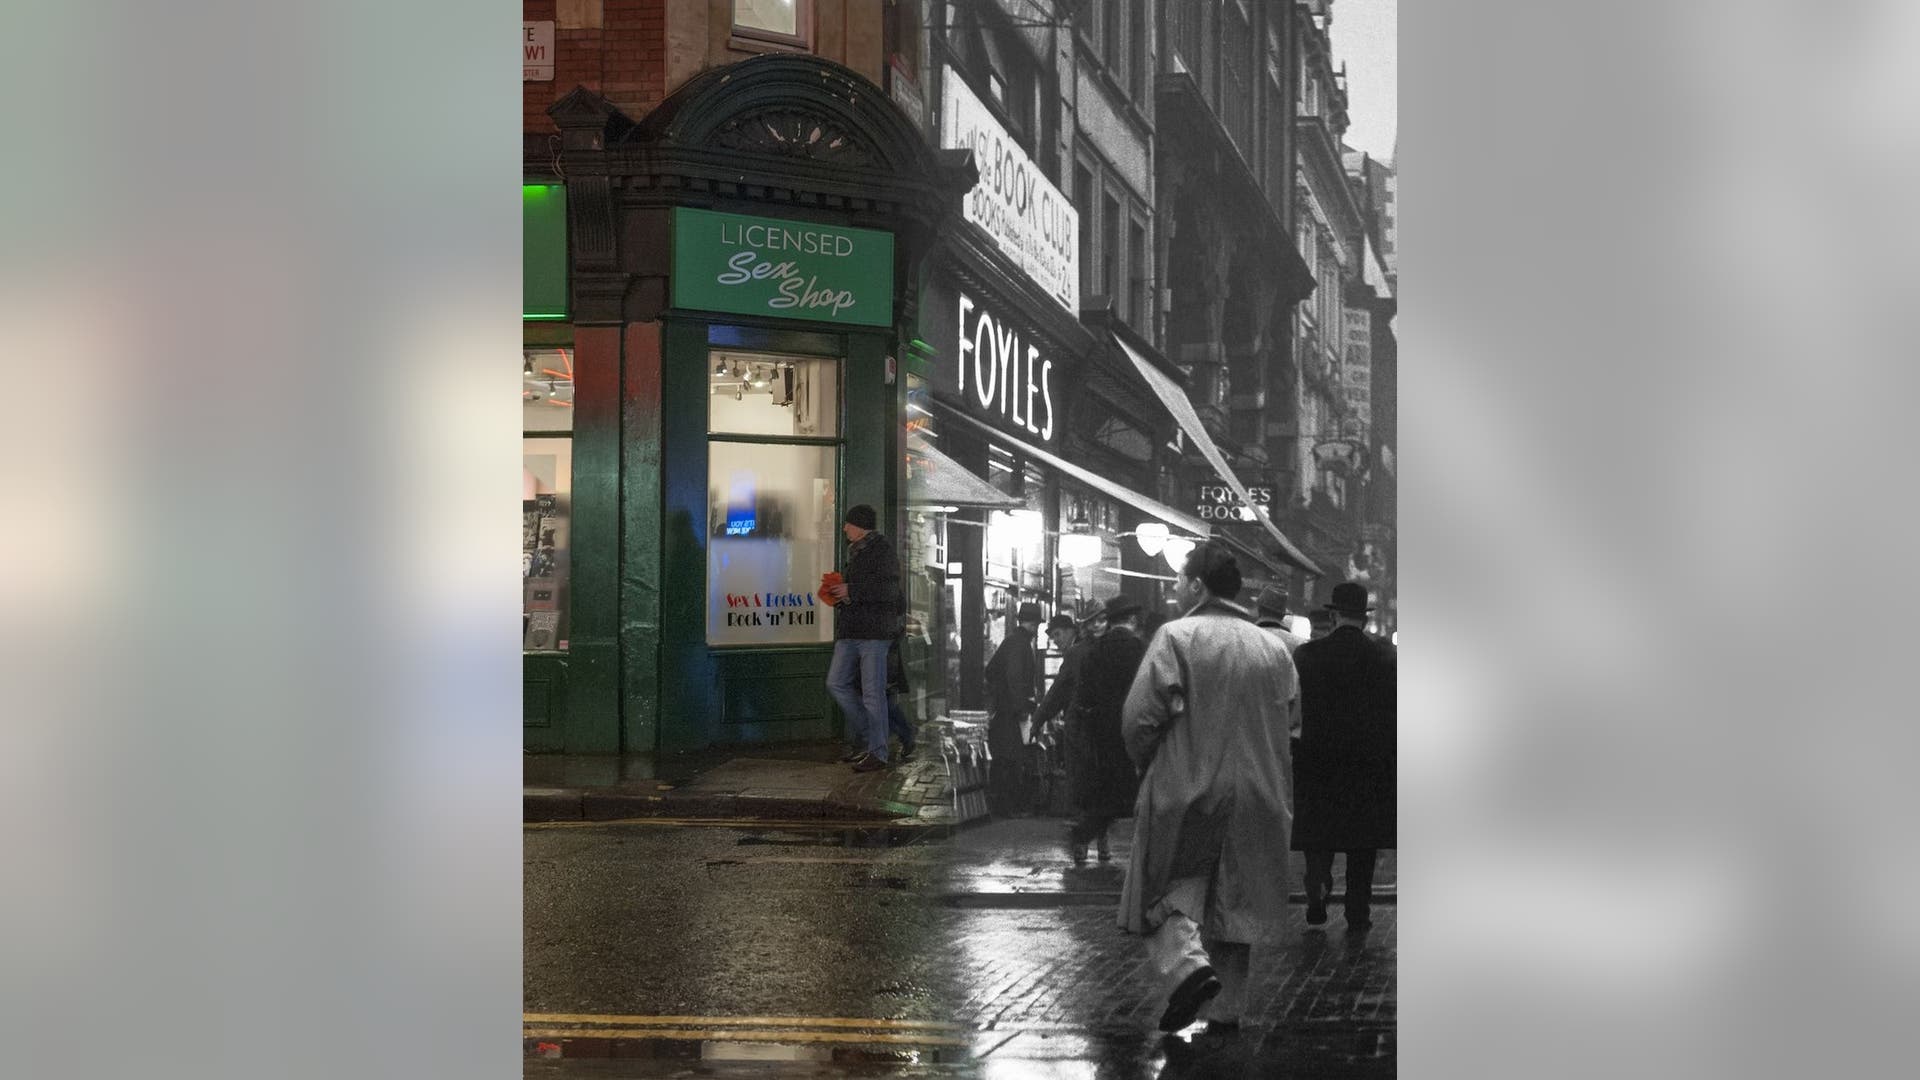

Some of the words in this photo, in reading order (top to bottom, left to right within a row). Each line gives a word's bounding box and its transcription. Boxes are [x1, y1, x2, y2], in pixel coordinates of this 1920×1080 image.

[525, 45, 545, 60] W1
[971, 186, 1002, 237] BOOKS
[994, 136, 1038, 230] BOOK
[1042, 190, 1072, 263] CLUB
[721, 223, 853, 257] LICENSED
[717, 251, 799, 285] Sex
[768, 275, 856, 317] Shop
[958, 292, 1053, 441] FOYLES
[727, 593, 749, 607] Sex
[766, 593, 802, 607] Books
[727, 611, 762, 626] Rock
[788, 610, 815, 625] Roll
